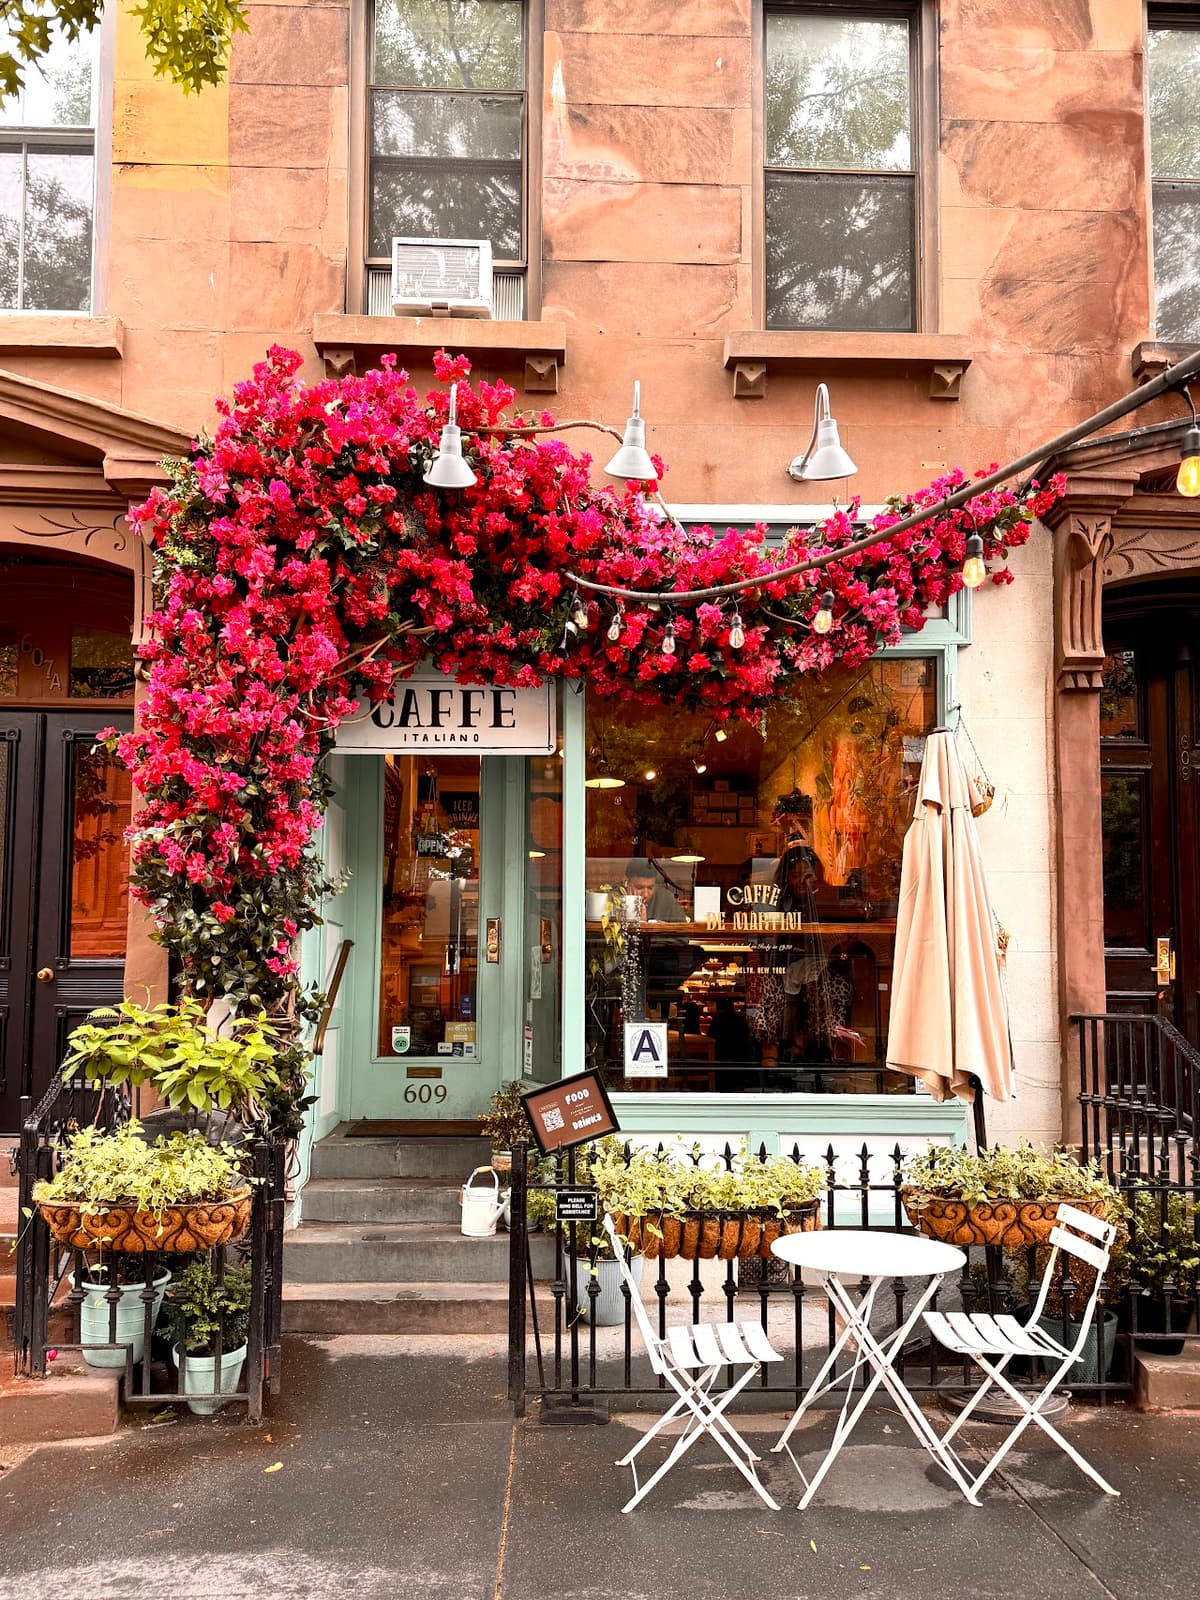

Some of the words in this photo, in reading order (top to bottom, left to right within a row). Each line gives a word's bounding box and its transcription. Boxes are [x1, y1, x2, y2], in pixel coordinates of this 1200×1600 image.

[403, 733, 480, 742] ITALIANO
[453, 800, 473, 811] ICED
[418, 840, 443, 853] OPEN
[727, 884, 781, 906] CAFFÈ
[706, 912, 726, 931] DE
[733, 912, 802, 931] MARTINI
[632, 1029, 660, 1061] A
[404, 1083, 447, 1104] 609
[565, 1088, 590, 1105] FOOD
